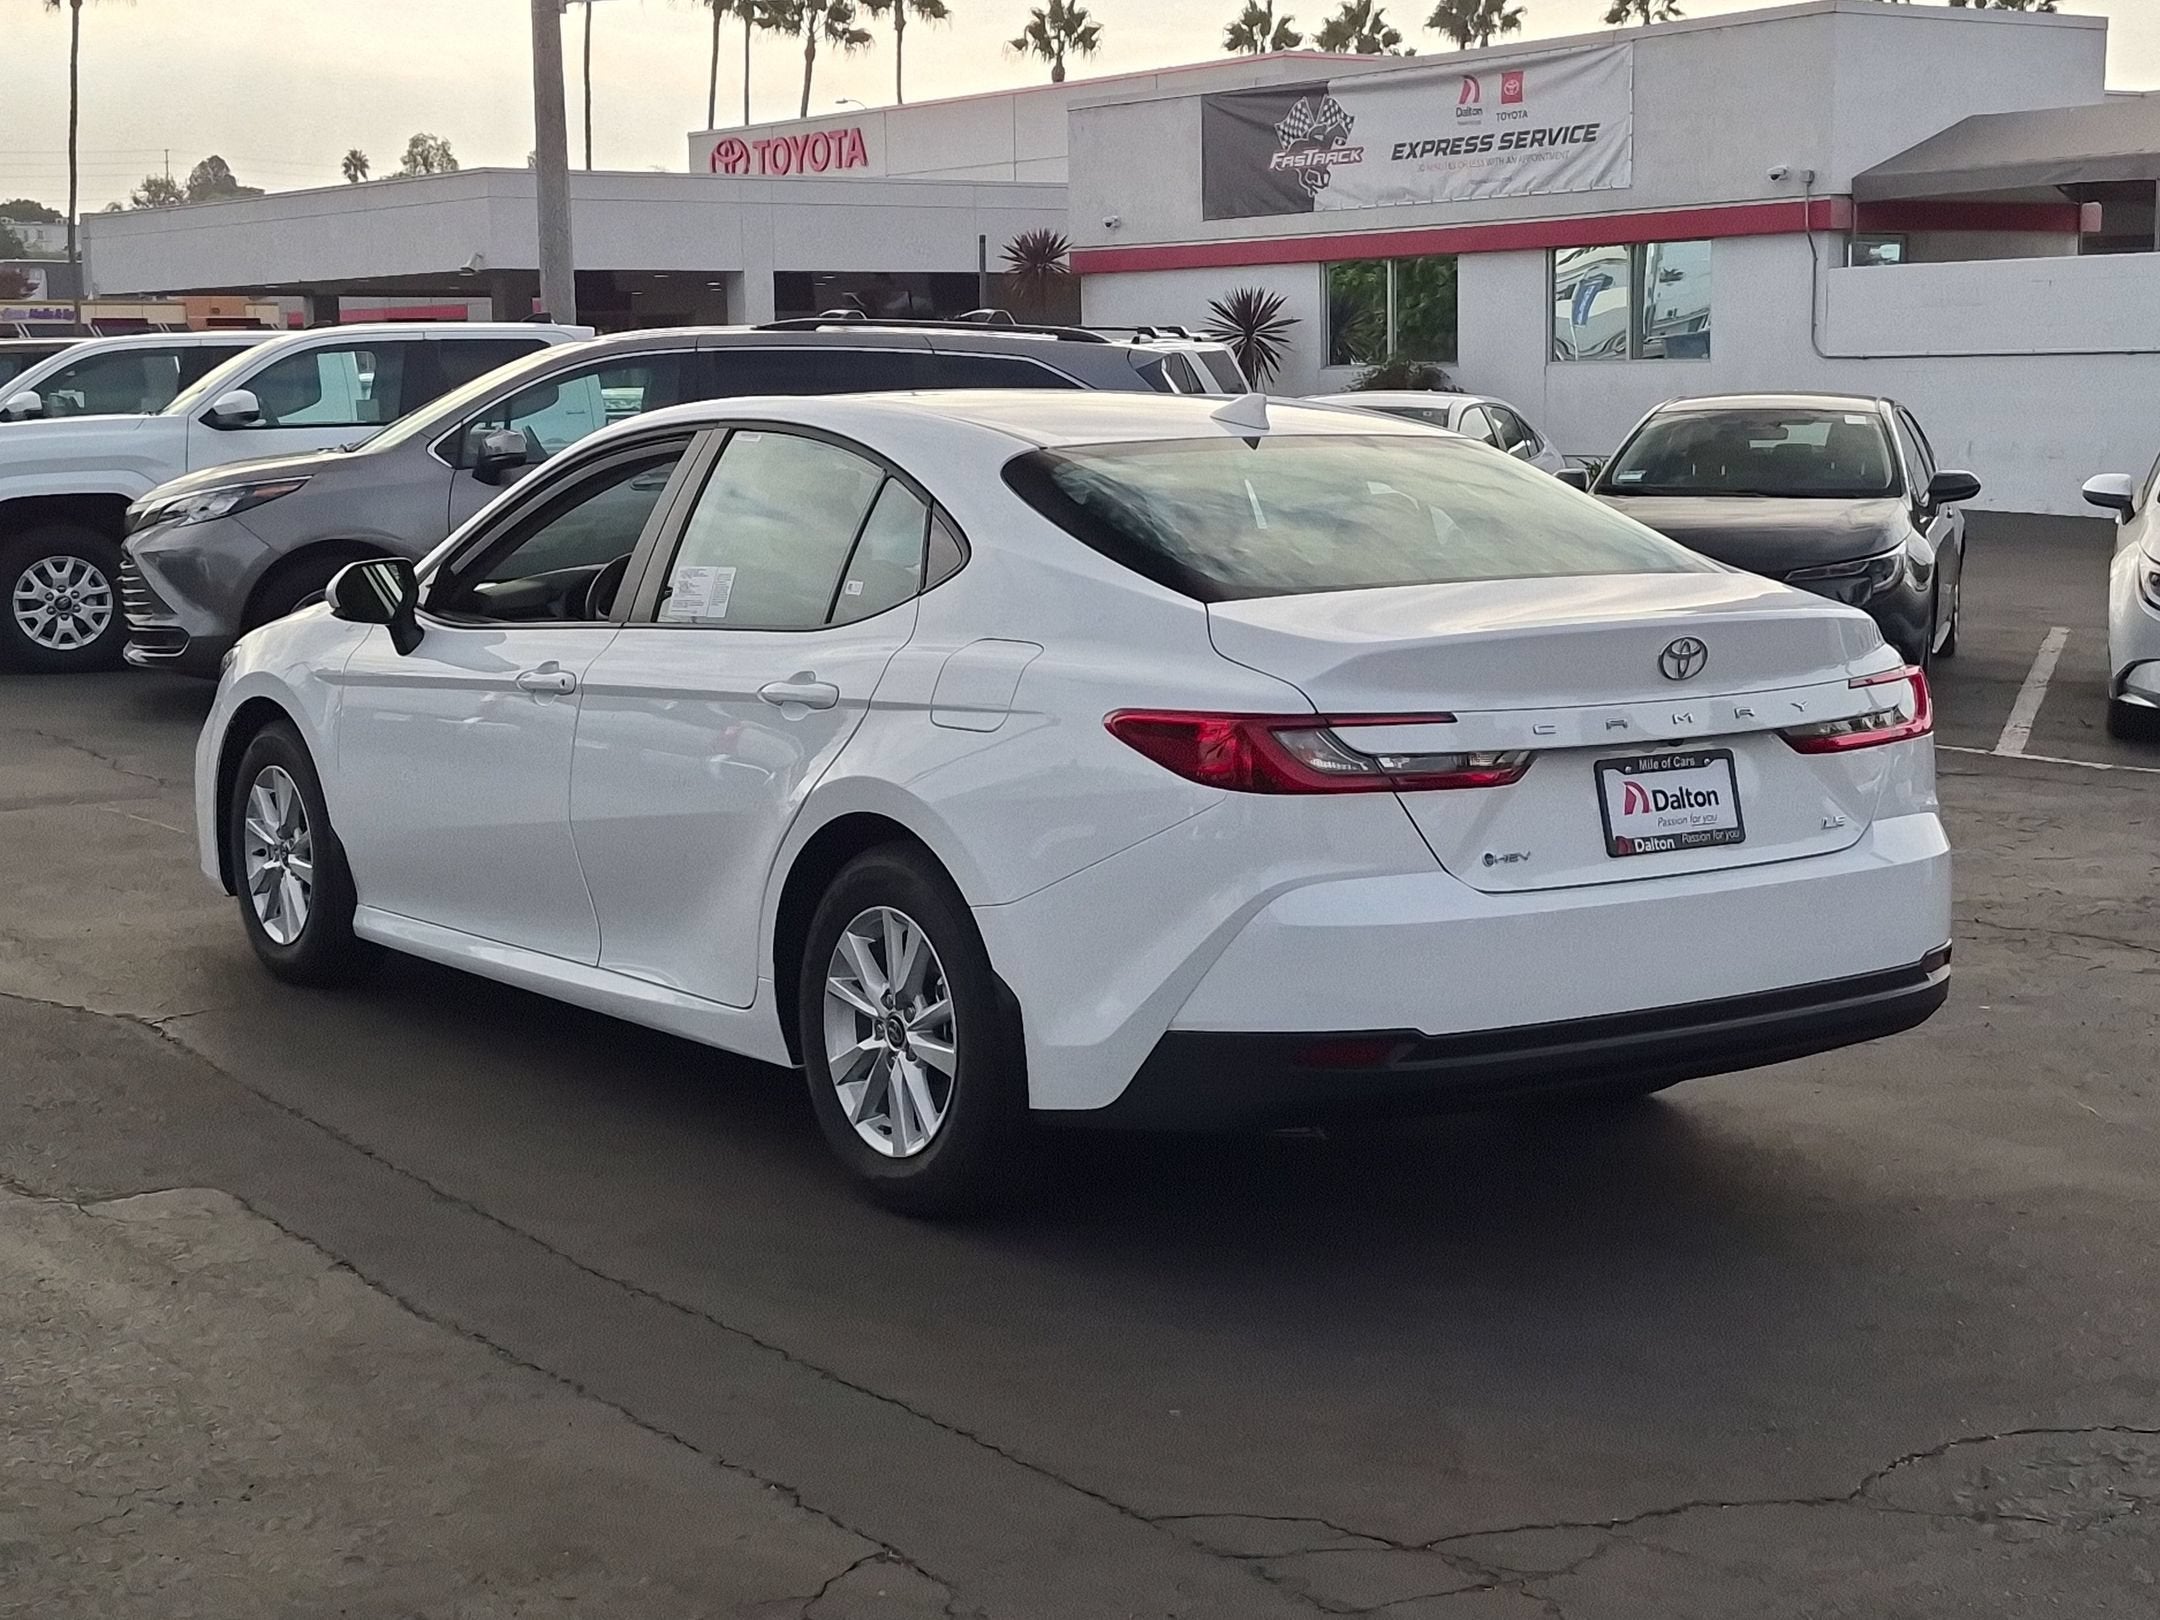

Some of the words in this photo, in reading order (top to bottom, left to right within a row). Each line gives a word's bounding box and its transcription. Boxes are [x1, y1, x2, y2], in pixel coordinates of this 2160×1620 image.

[1456, 106, 1483, 118] Dalton
[1496, 109, 1528, 122] TOYOTA
[752, 127, 868, 175] TOYOTA
[1391, 133, 1495, 161] EXPRESS
[1497, 122, 1601, 151] SERVICE
[1533, 701, 1807, 736] CAMRY
[1639, 757, 1659, 770] Mile
[1661, 757, 1671, 769] of
[1673, 755, 1695, 768] Cars
[1651, 785, 1719, 812] Dalton
[1657, 816, 1688, 828] Passion
[1689, 813, 1702, 825] for
[1702, 813, 1718, 825] you
[1633, 837, 1676, 854] Dalton
[1682, 832, 1711, 844] Passion
[1712, 829, 1725, 841] for
[1725, 829, 1741, 841] you
